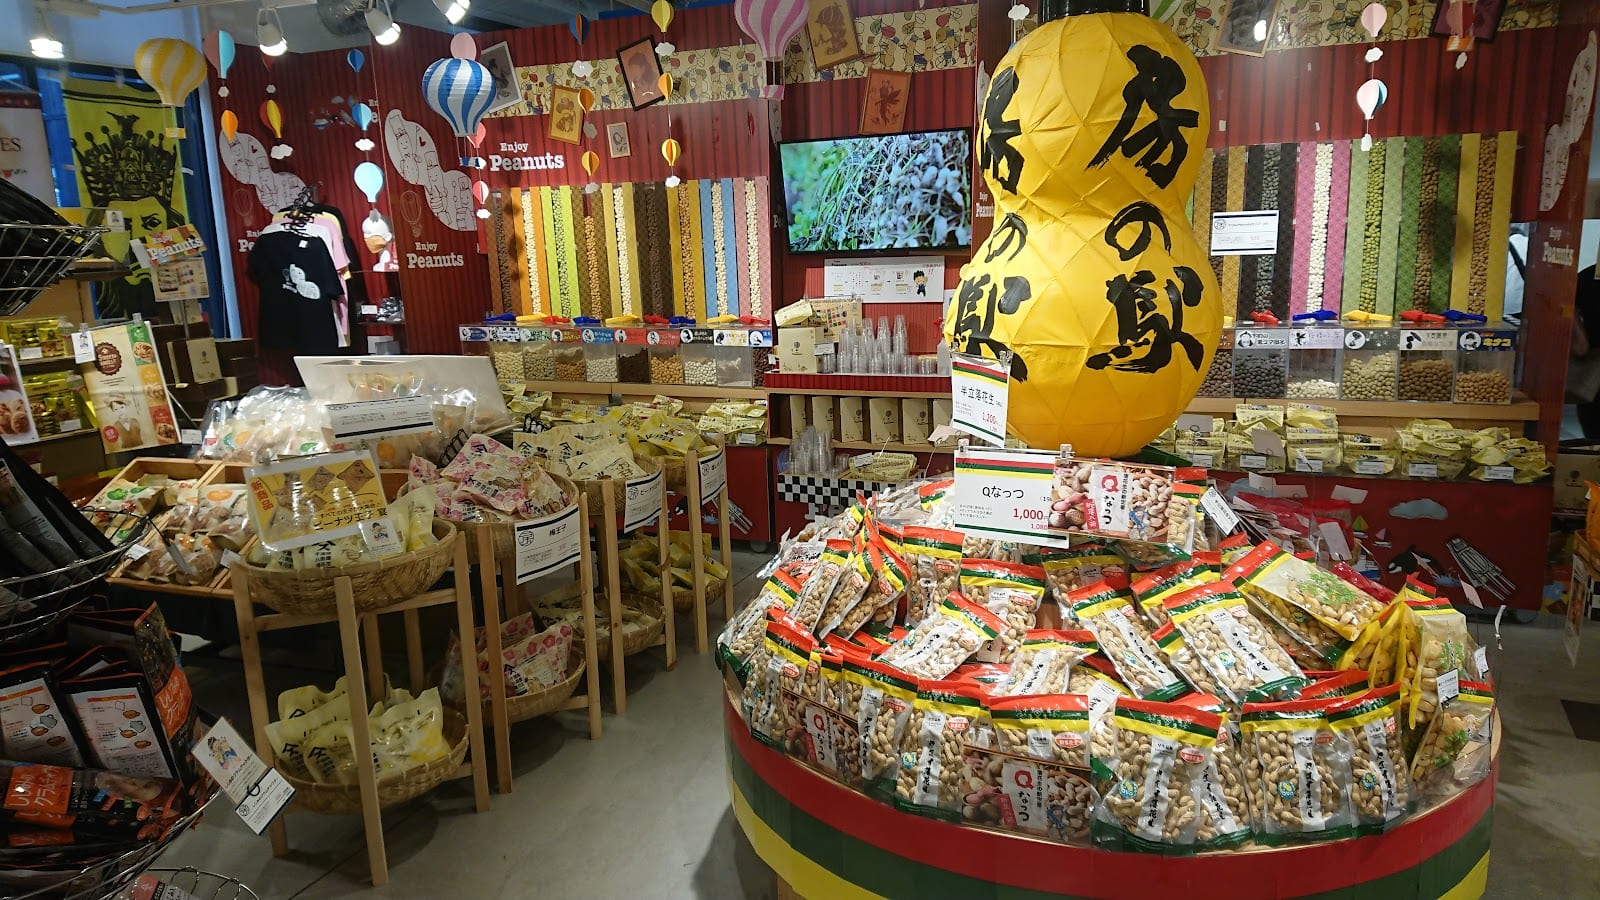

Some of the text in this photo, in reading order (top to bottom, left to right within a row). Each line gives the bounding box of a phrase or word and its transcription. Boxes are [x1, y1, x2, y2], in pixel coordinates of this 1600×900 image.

[500, 142, 528, 153] Enjoy
[489, 152, 565, 172] Peanuts
[976, 202, 995, 218] Peanut
[1085, 44, 1203, 371] 房の駅
[147, 237, 203, 261] Peanuts
[415, 241, 438, 252] Enjoy
[407, 252, 464, 269] Peanuts
[982, 485, 1025, 499] Qなっつ
[1012, 508, 1044, 521] 1,000
